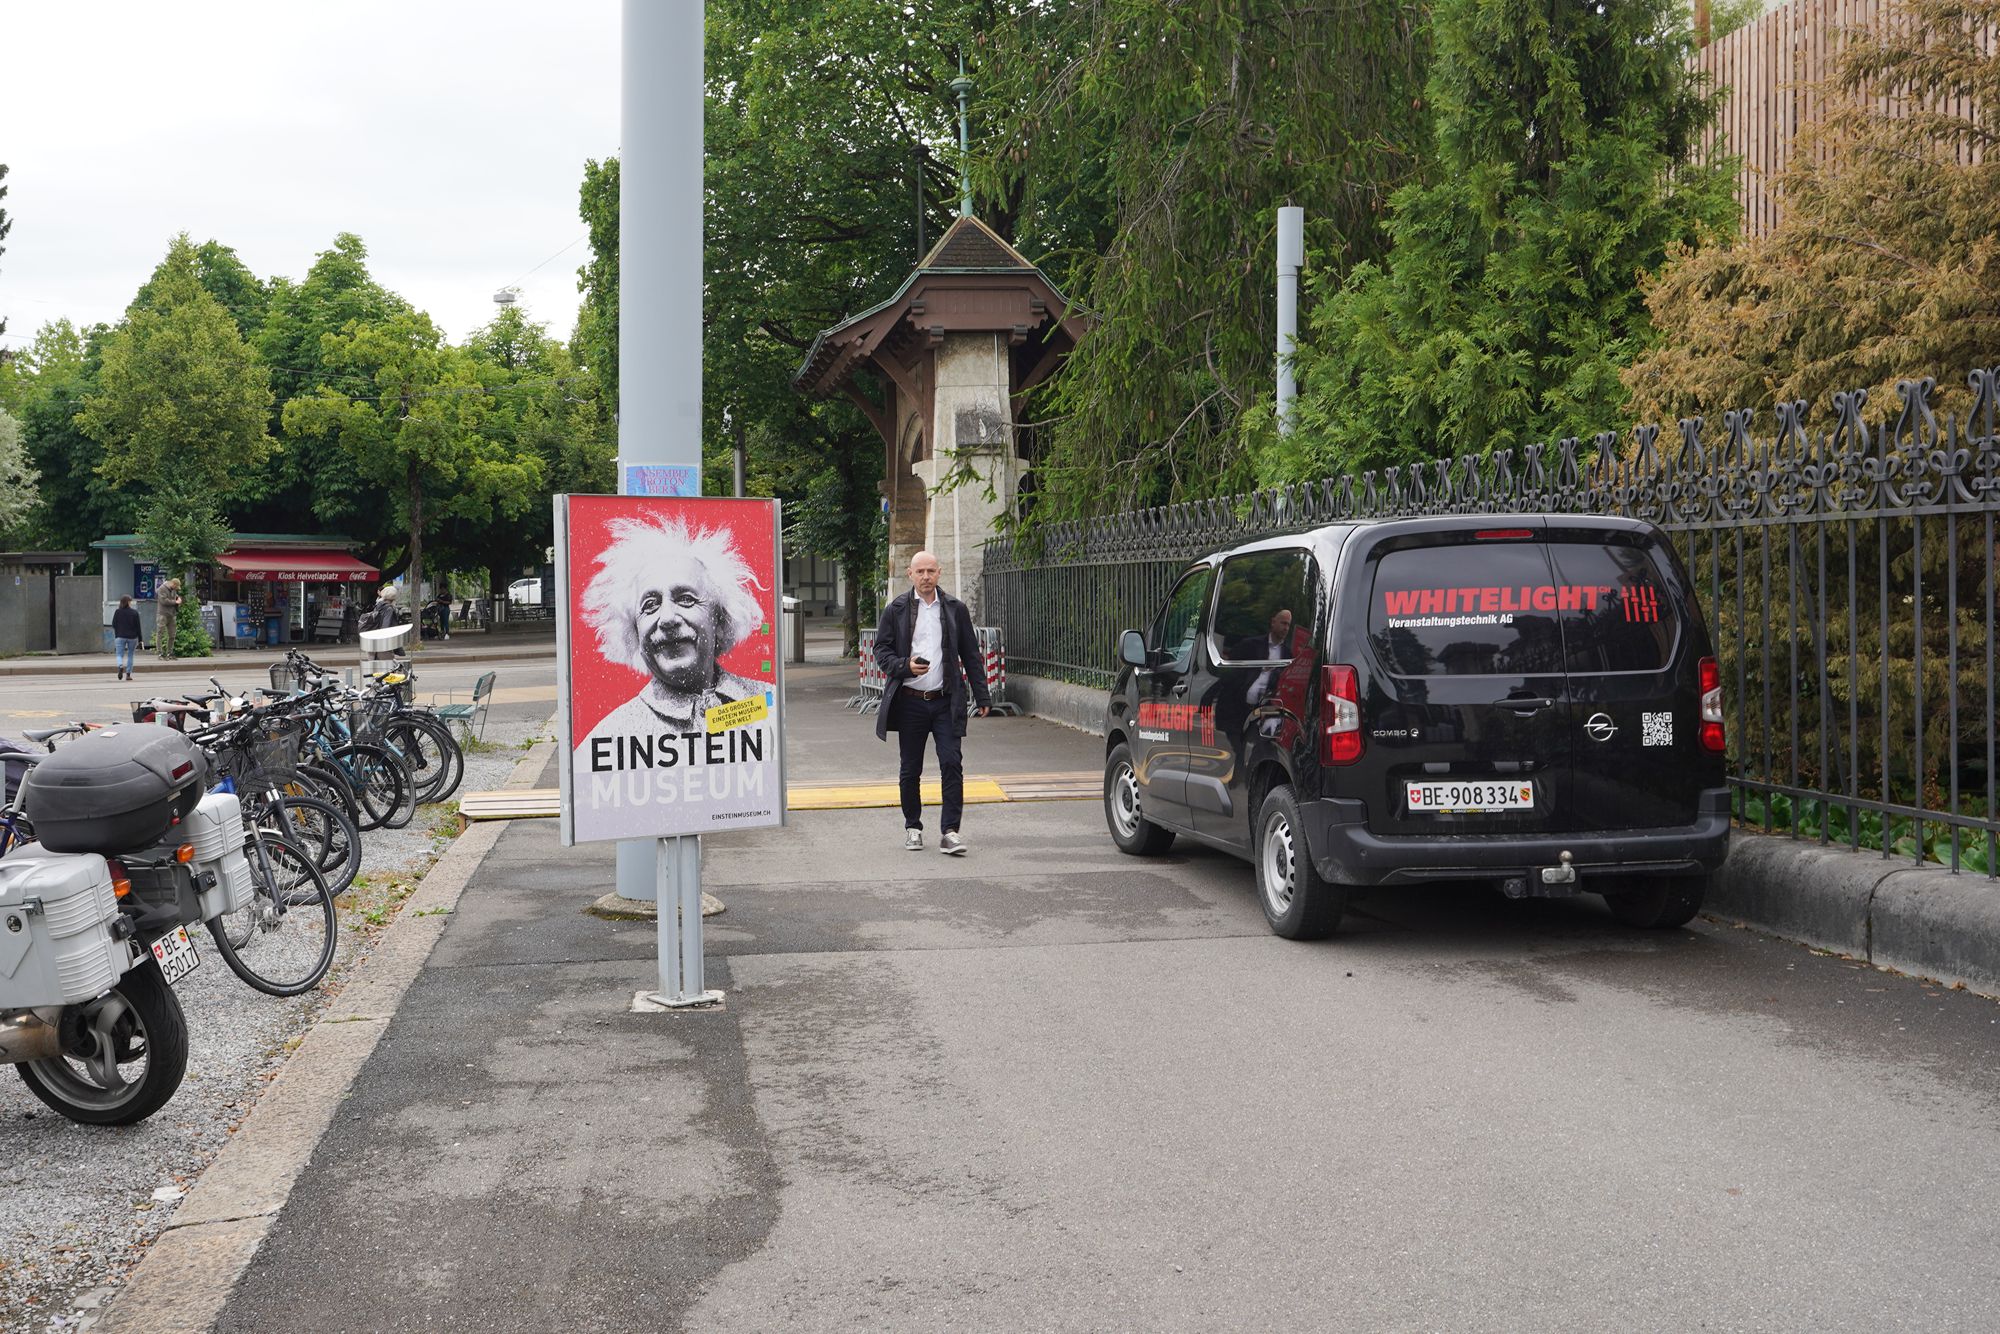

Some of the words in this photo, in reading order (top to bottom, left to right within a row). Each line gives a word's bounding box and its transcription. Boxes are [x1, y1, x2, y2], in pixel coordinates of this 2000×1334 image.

[635, 468, 689, 479] ENSEMBLE
[278, 571, 296, 580] Kiosk
[297, 571, 339, 581] Helvetiaplatz
[1385, 585, 1598, 616] WHITELIGHT
[1388, 615, 1497, 629] Veranstaltungstechnik
[1499, 613, 1513, 624] AG
[711, 712, 738, 724] EINSTEIN
[738, 705, 762, 717] MUSEUM
[717, 706, 729, 715] DAS
[737, 714, 752, 723] WELT
[591, 728, 763, 772] EINSTEIN
[591, 764, 763, 810] MUSEUM
[711, 810, 771, 821] EINSTEINMUSEUM.CH
[161, 932, 180, 956] BE
[162, 946, 196, 983] 95017
